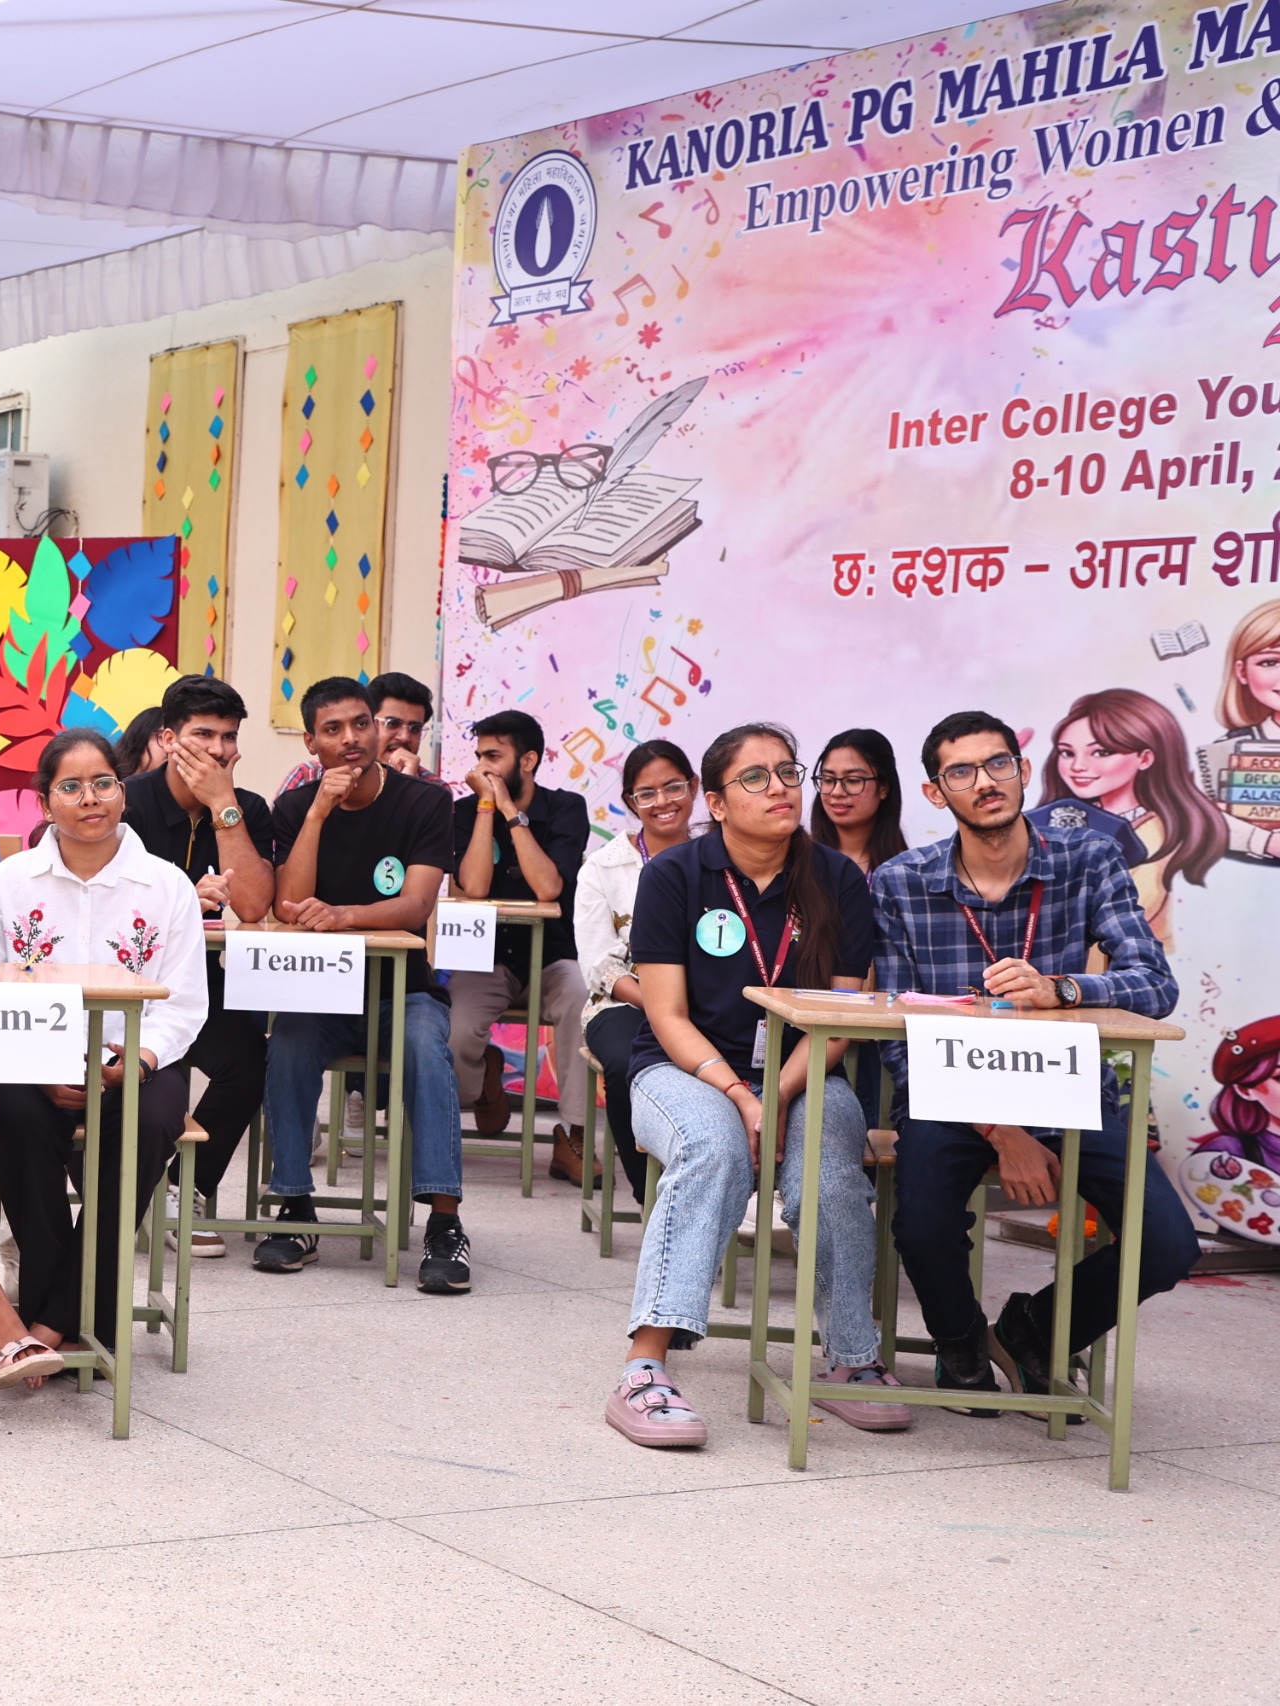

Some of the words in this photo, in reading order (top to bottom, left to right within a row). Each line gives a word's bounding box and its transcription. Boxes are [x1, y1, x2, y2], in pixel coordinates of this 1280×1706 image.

[625, 101, 829, 190] KANORIA
[847, 80, 914, 143] PG
[934, 25, 1164, 125] MAHILA
[743, 144, 1017, 232] Empowering
[1033, 106, 1225, 176] Women
[888, 409, 988, 449] Inter
[1002, 391, 1178, 440] College
[1009, 452, 1107, 499] 8-10
[1120, 441, 1254, 501] April,
[891, 545, 1010, 598] दशक
[1070, 536, 1197, 589] आत्म
[385, 868, 395, 890] 5
[436, 919, 485, 938] m-8
[715, 925, 724, 949] 1
[1026, 912, 1035, 941] UNIVERSITY
[246, 945, 355, 975] Team-5
[751, 940, 763, 967] UNIVERSITY
[935, 1038, 1082, 1075] Team-1
